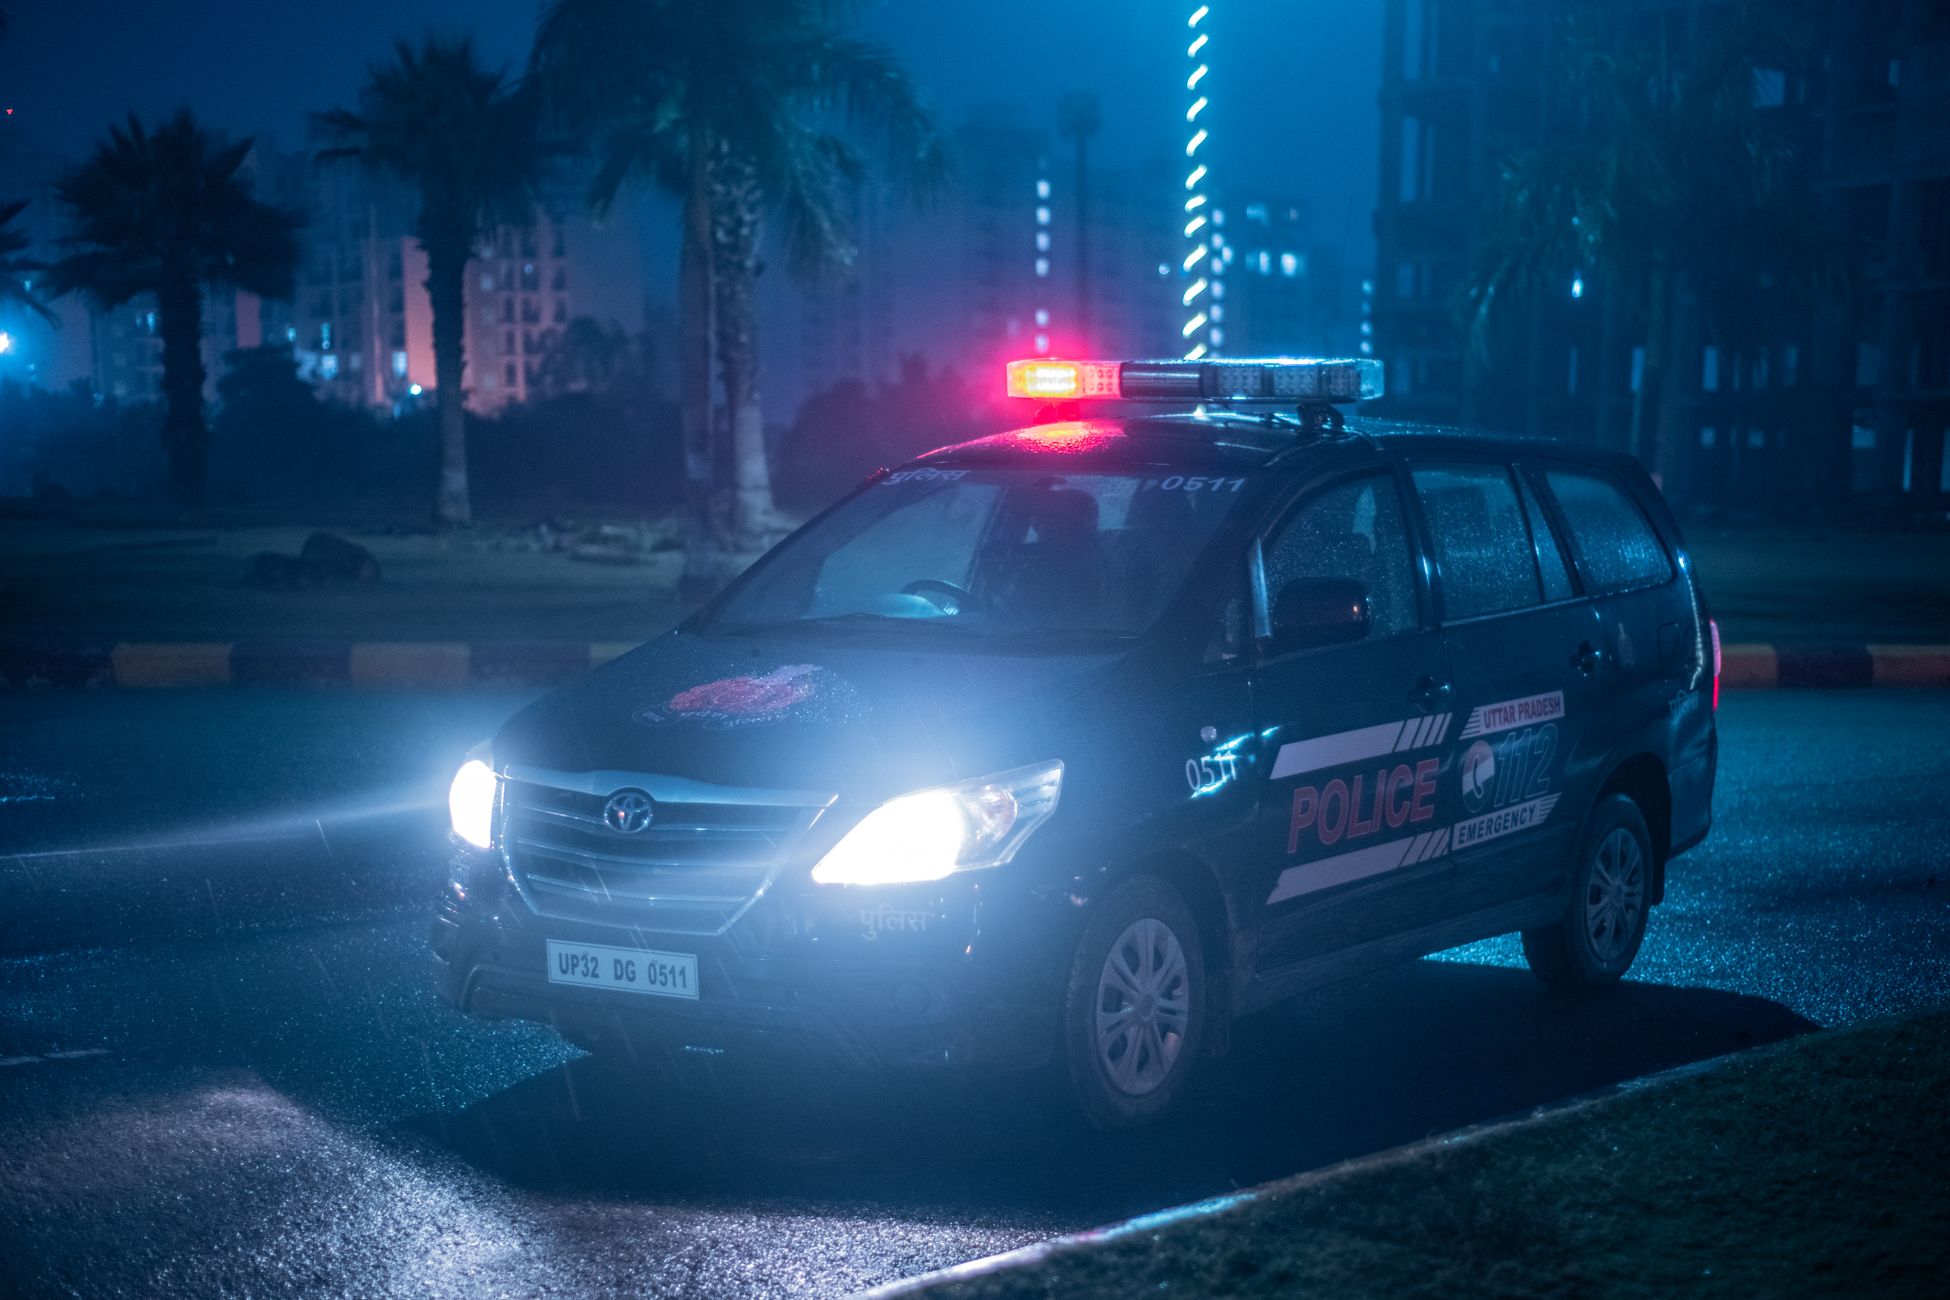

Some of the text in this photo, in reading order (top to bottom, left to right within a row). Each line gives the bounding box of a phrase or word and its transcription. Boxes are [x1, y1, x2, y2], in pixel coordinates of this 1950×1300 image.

[1161, 475, 1247, 492] 0511
[1483, 696, 1561, 729] UTTAR PRADESH
[1185, 750, 1237, 790] 0511
[1494, 723, 1559, 808] 112
[1287, 757, 1440, 854] POLICE
[1458, 804, 1537, 845] EMERGENCY
[860, 901, 930, 941] पुलिस
[558, 951, 687, 988] UP32 DG 0511
